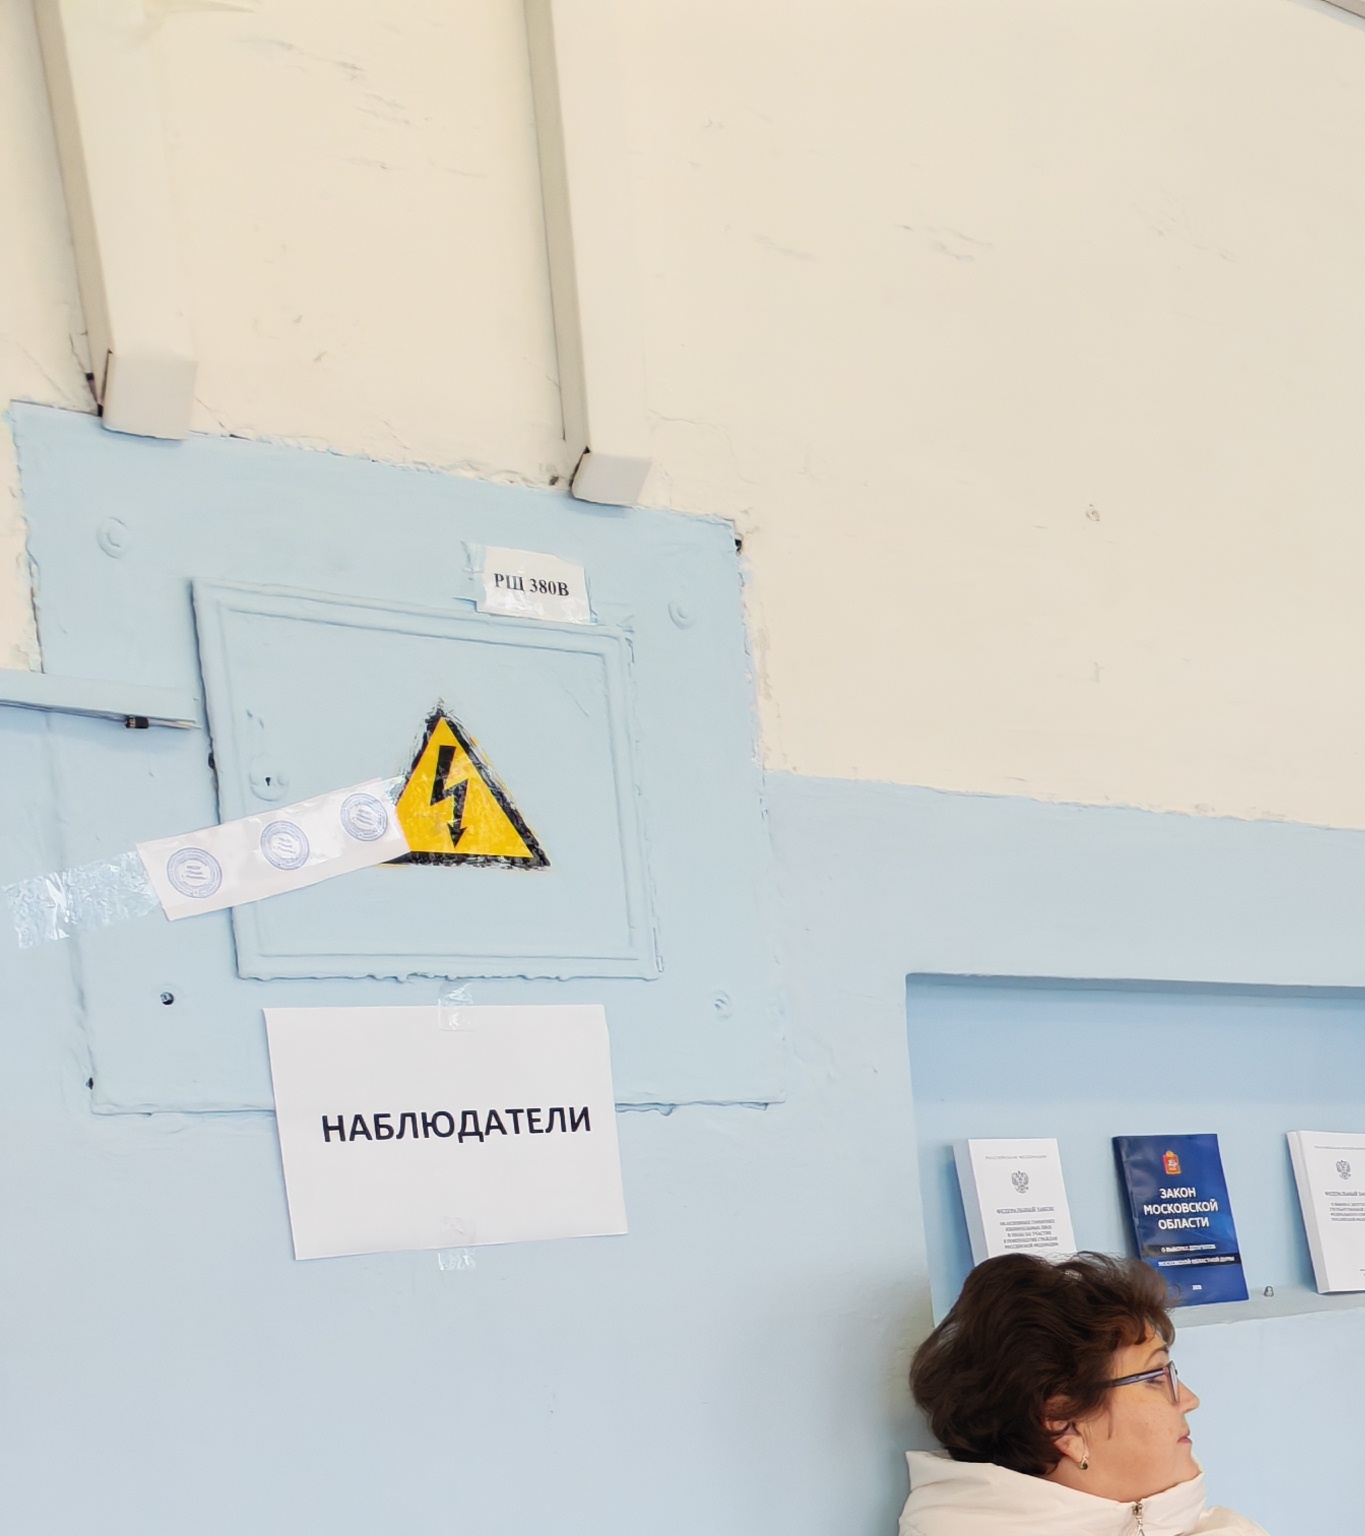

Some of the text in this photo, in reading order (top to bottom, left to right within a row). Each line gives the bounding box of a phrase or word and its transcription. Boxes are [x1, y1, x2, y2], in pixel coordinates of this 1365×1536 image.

[529, 578, 569, 597] 380В
[321, 1106, 591, 1144] НАБЛЮДАТЕЛИ
[1158, 1187, 1197, 1199] ЗАКОН
[1143, 1199, 1219, 1216] МОСКОВСКОЙ
[1158, 1217, 1210, 1230] ОБЛАСТИ
